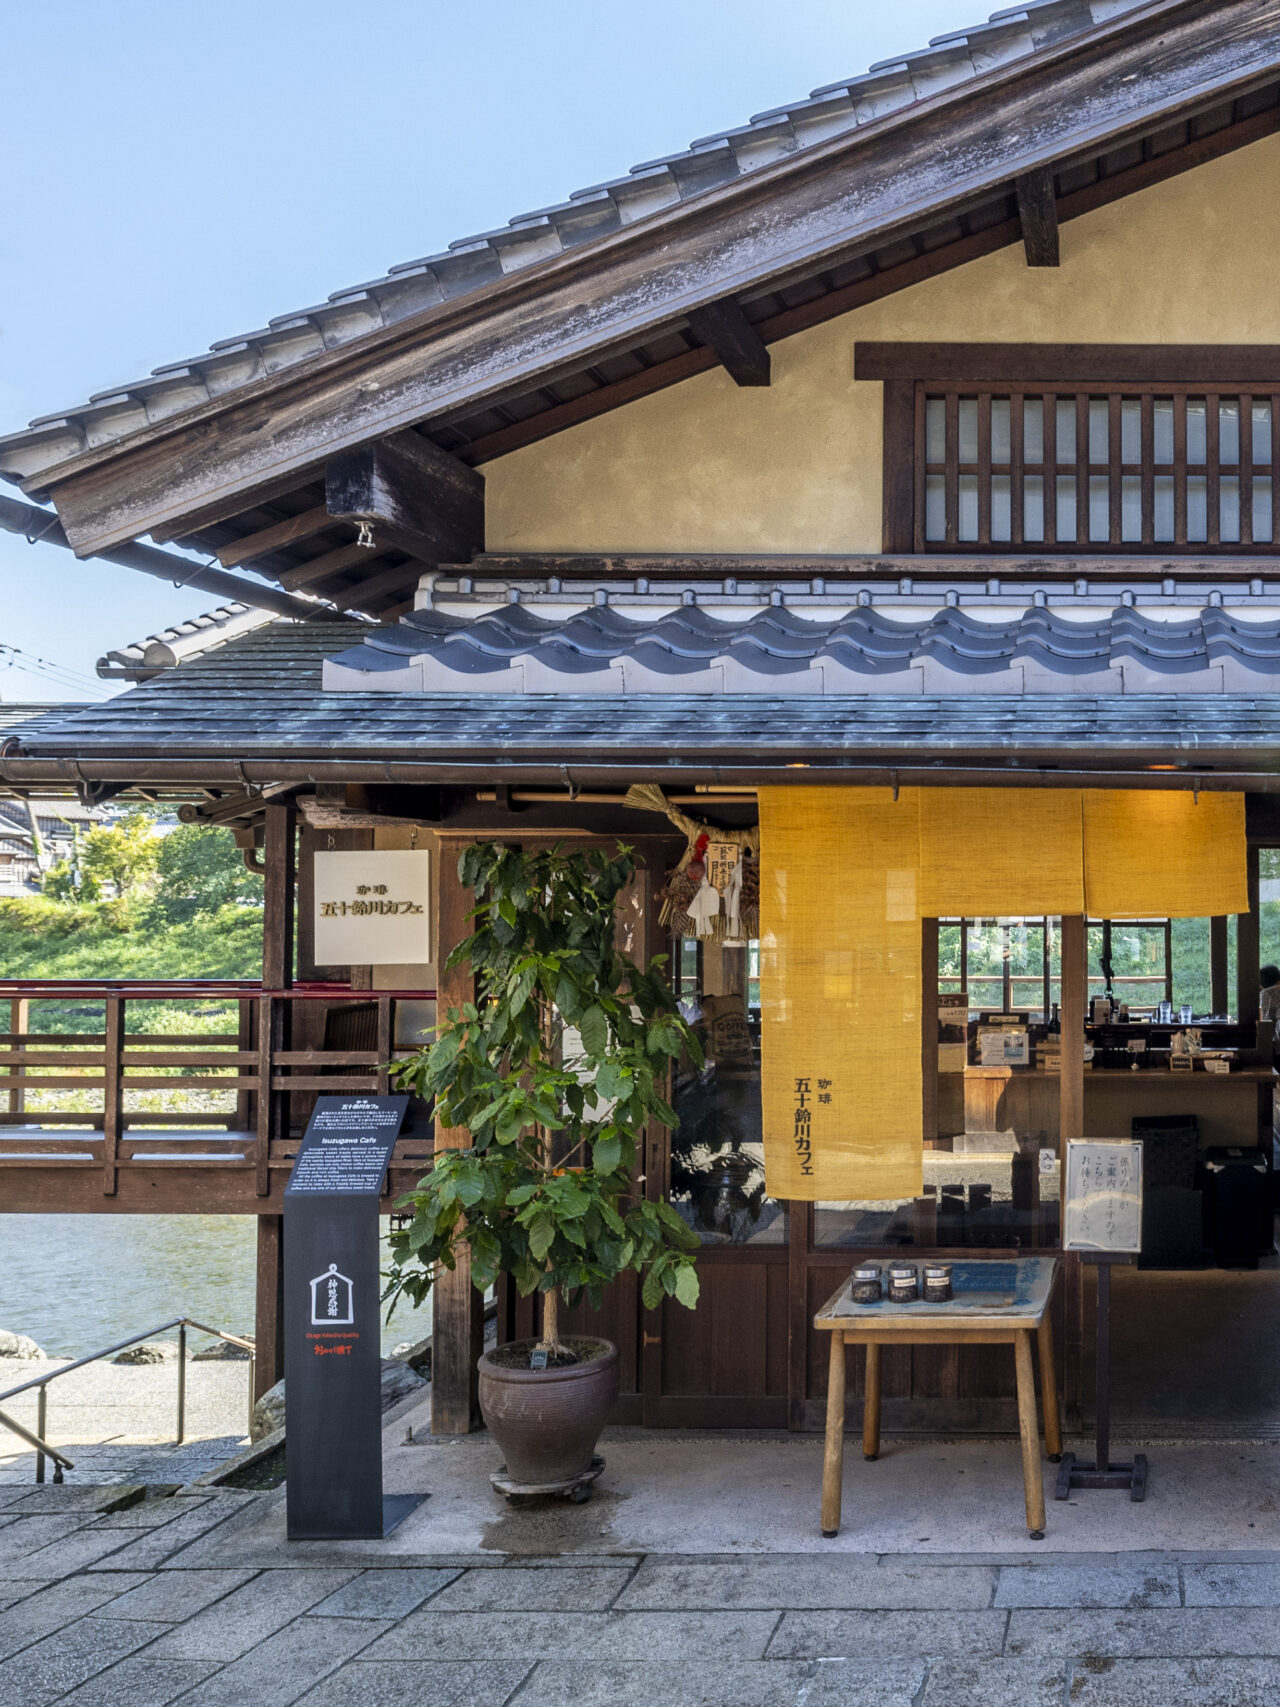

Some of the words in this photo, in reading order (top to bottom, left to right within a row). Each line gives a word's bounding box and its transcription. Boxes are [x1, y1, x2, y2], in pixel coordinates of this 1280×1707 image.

[356, 885, 388, 895] 珈琲
[320, 900, 424, 917] 五十鈴川カフェ
[817, 1079, 832, 1104] 珈琲
[794, 1078, 814, 1176] 五十鈴川カフェ
[1043, 1153, 1053, 1170] 入口
